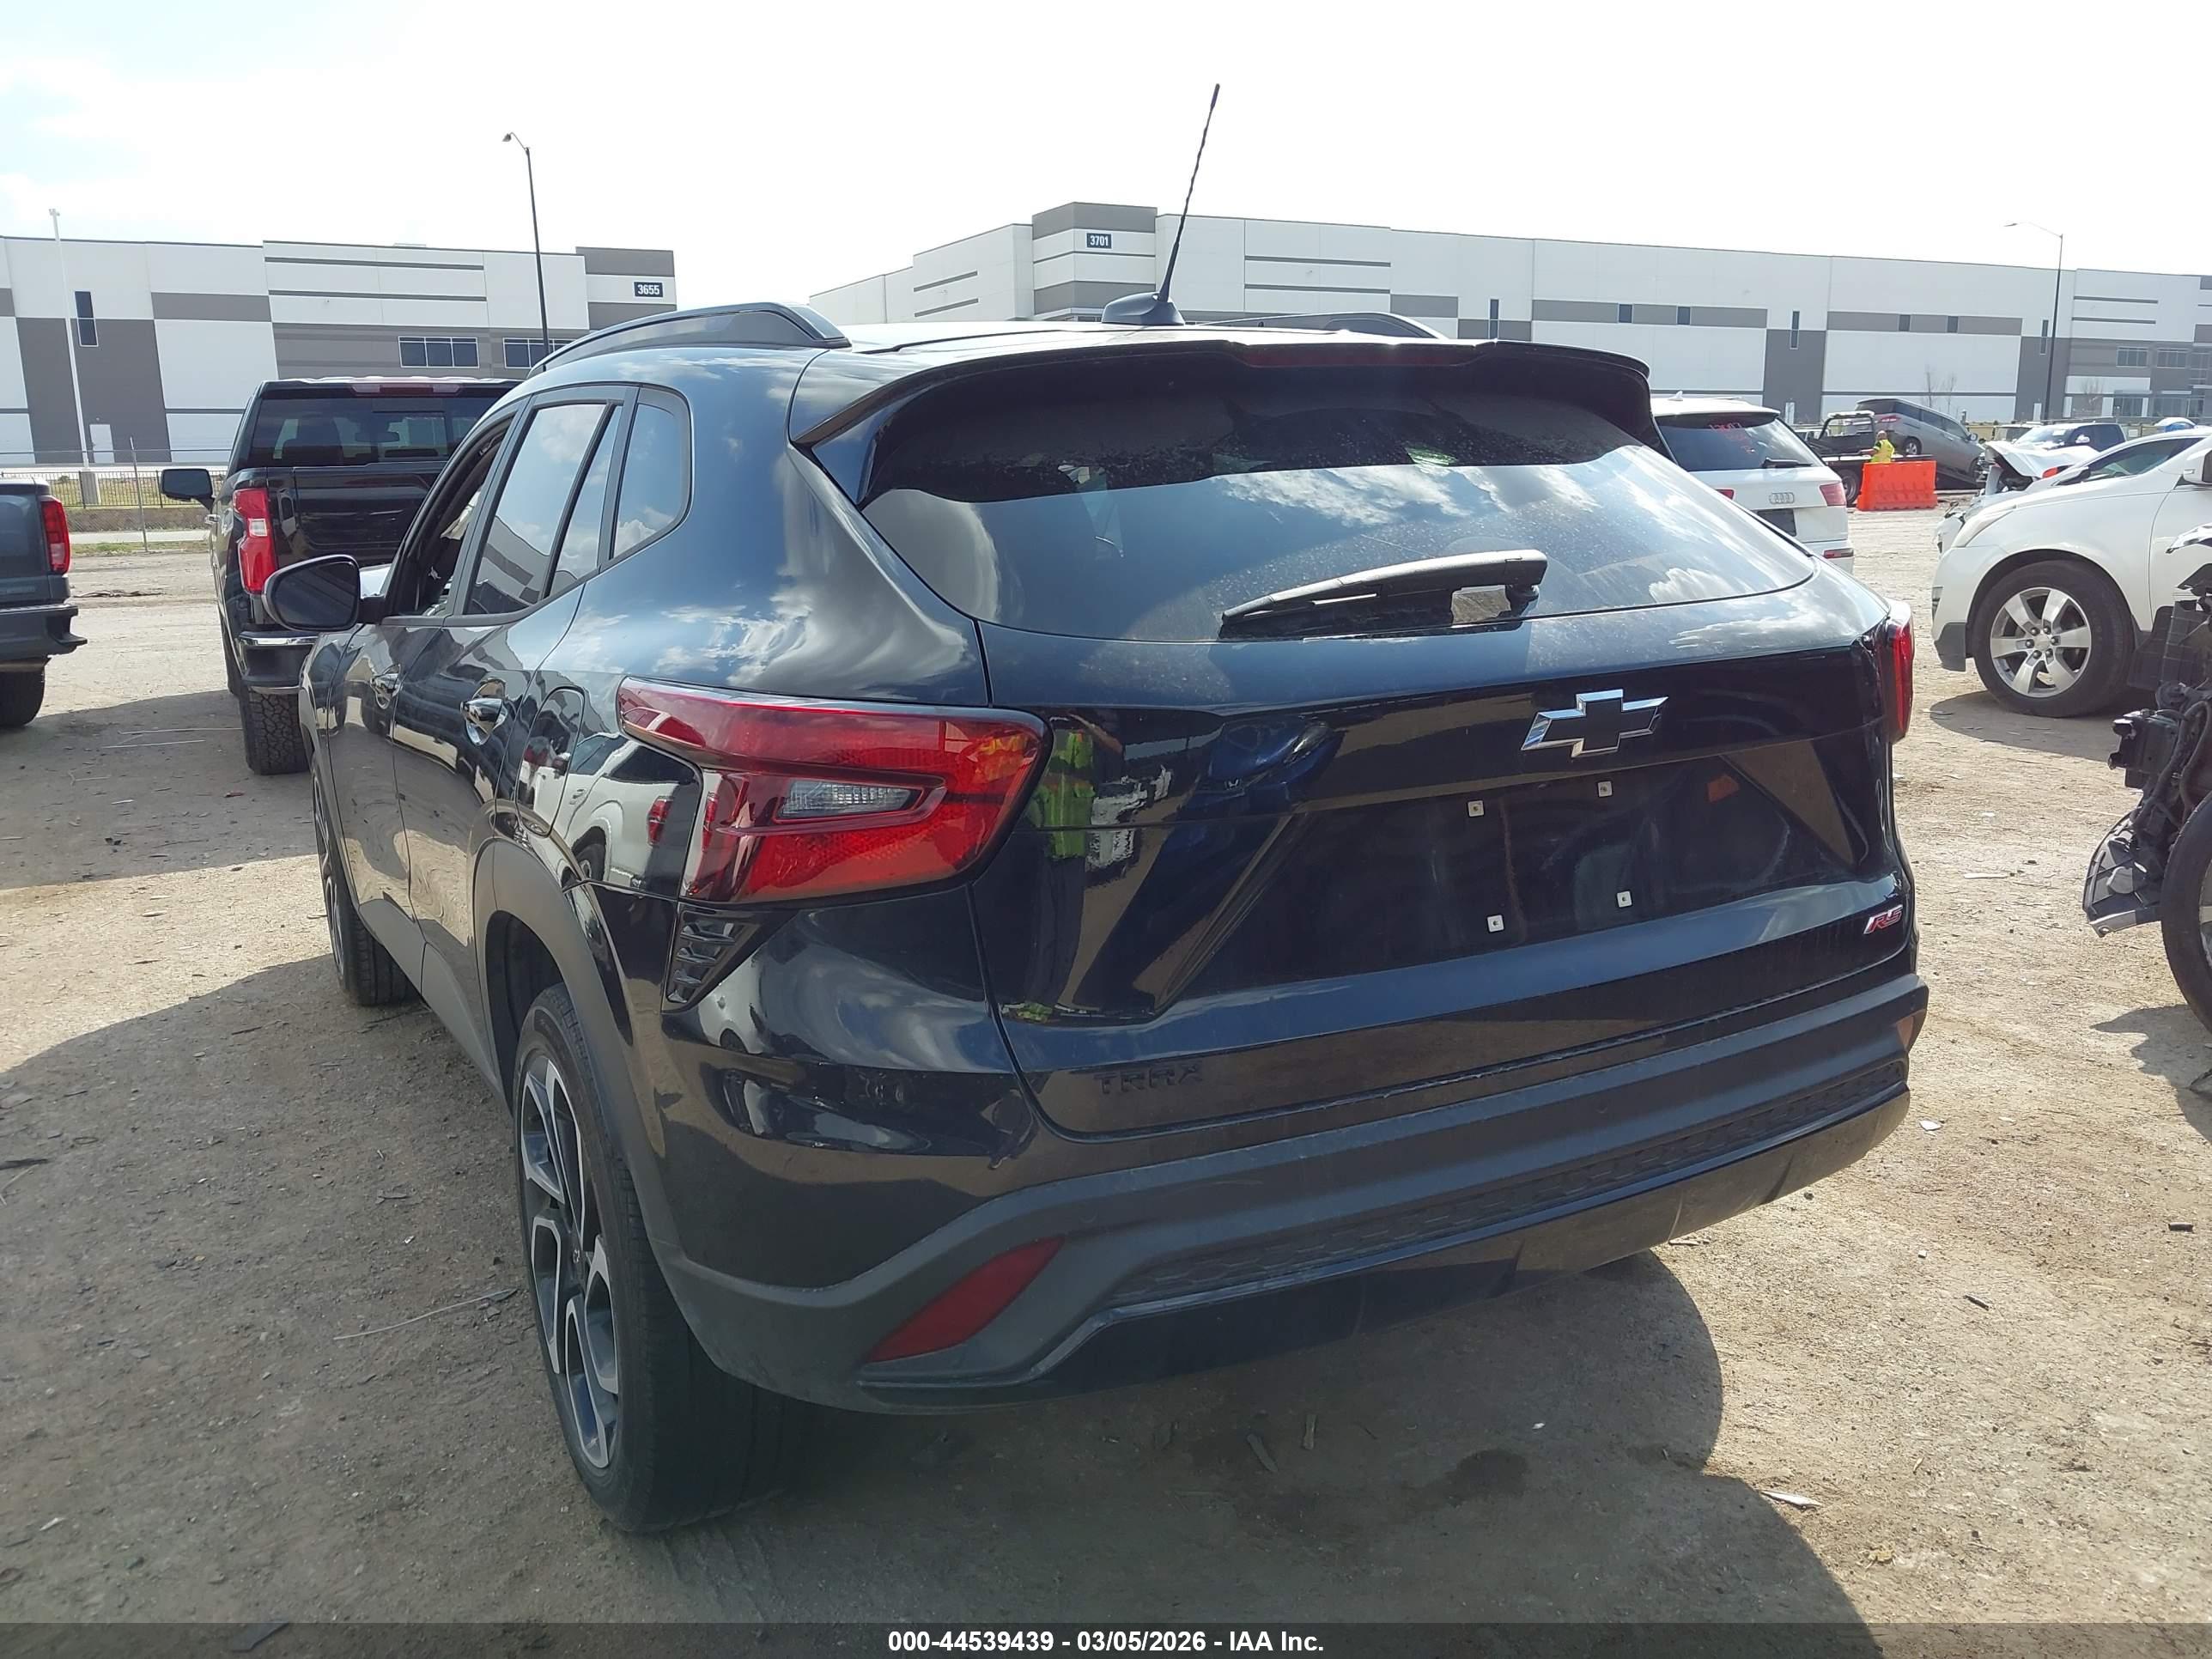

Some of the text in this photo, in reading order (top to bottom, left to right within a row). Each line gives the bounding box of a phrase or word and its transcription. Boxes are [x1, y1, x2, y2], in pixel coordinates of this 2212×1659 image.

[1090, 234, 1109, 246] 3701
[637, 284, 660, 295] 3655
[1863, 904, 1904, 934] RS
[1093, 1063, 1203, 1095] TRAX
